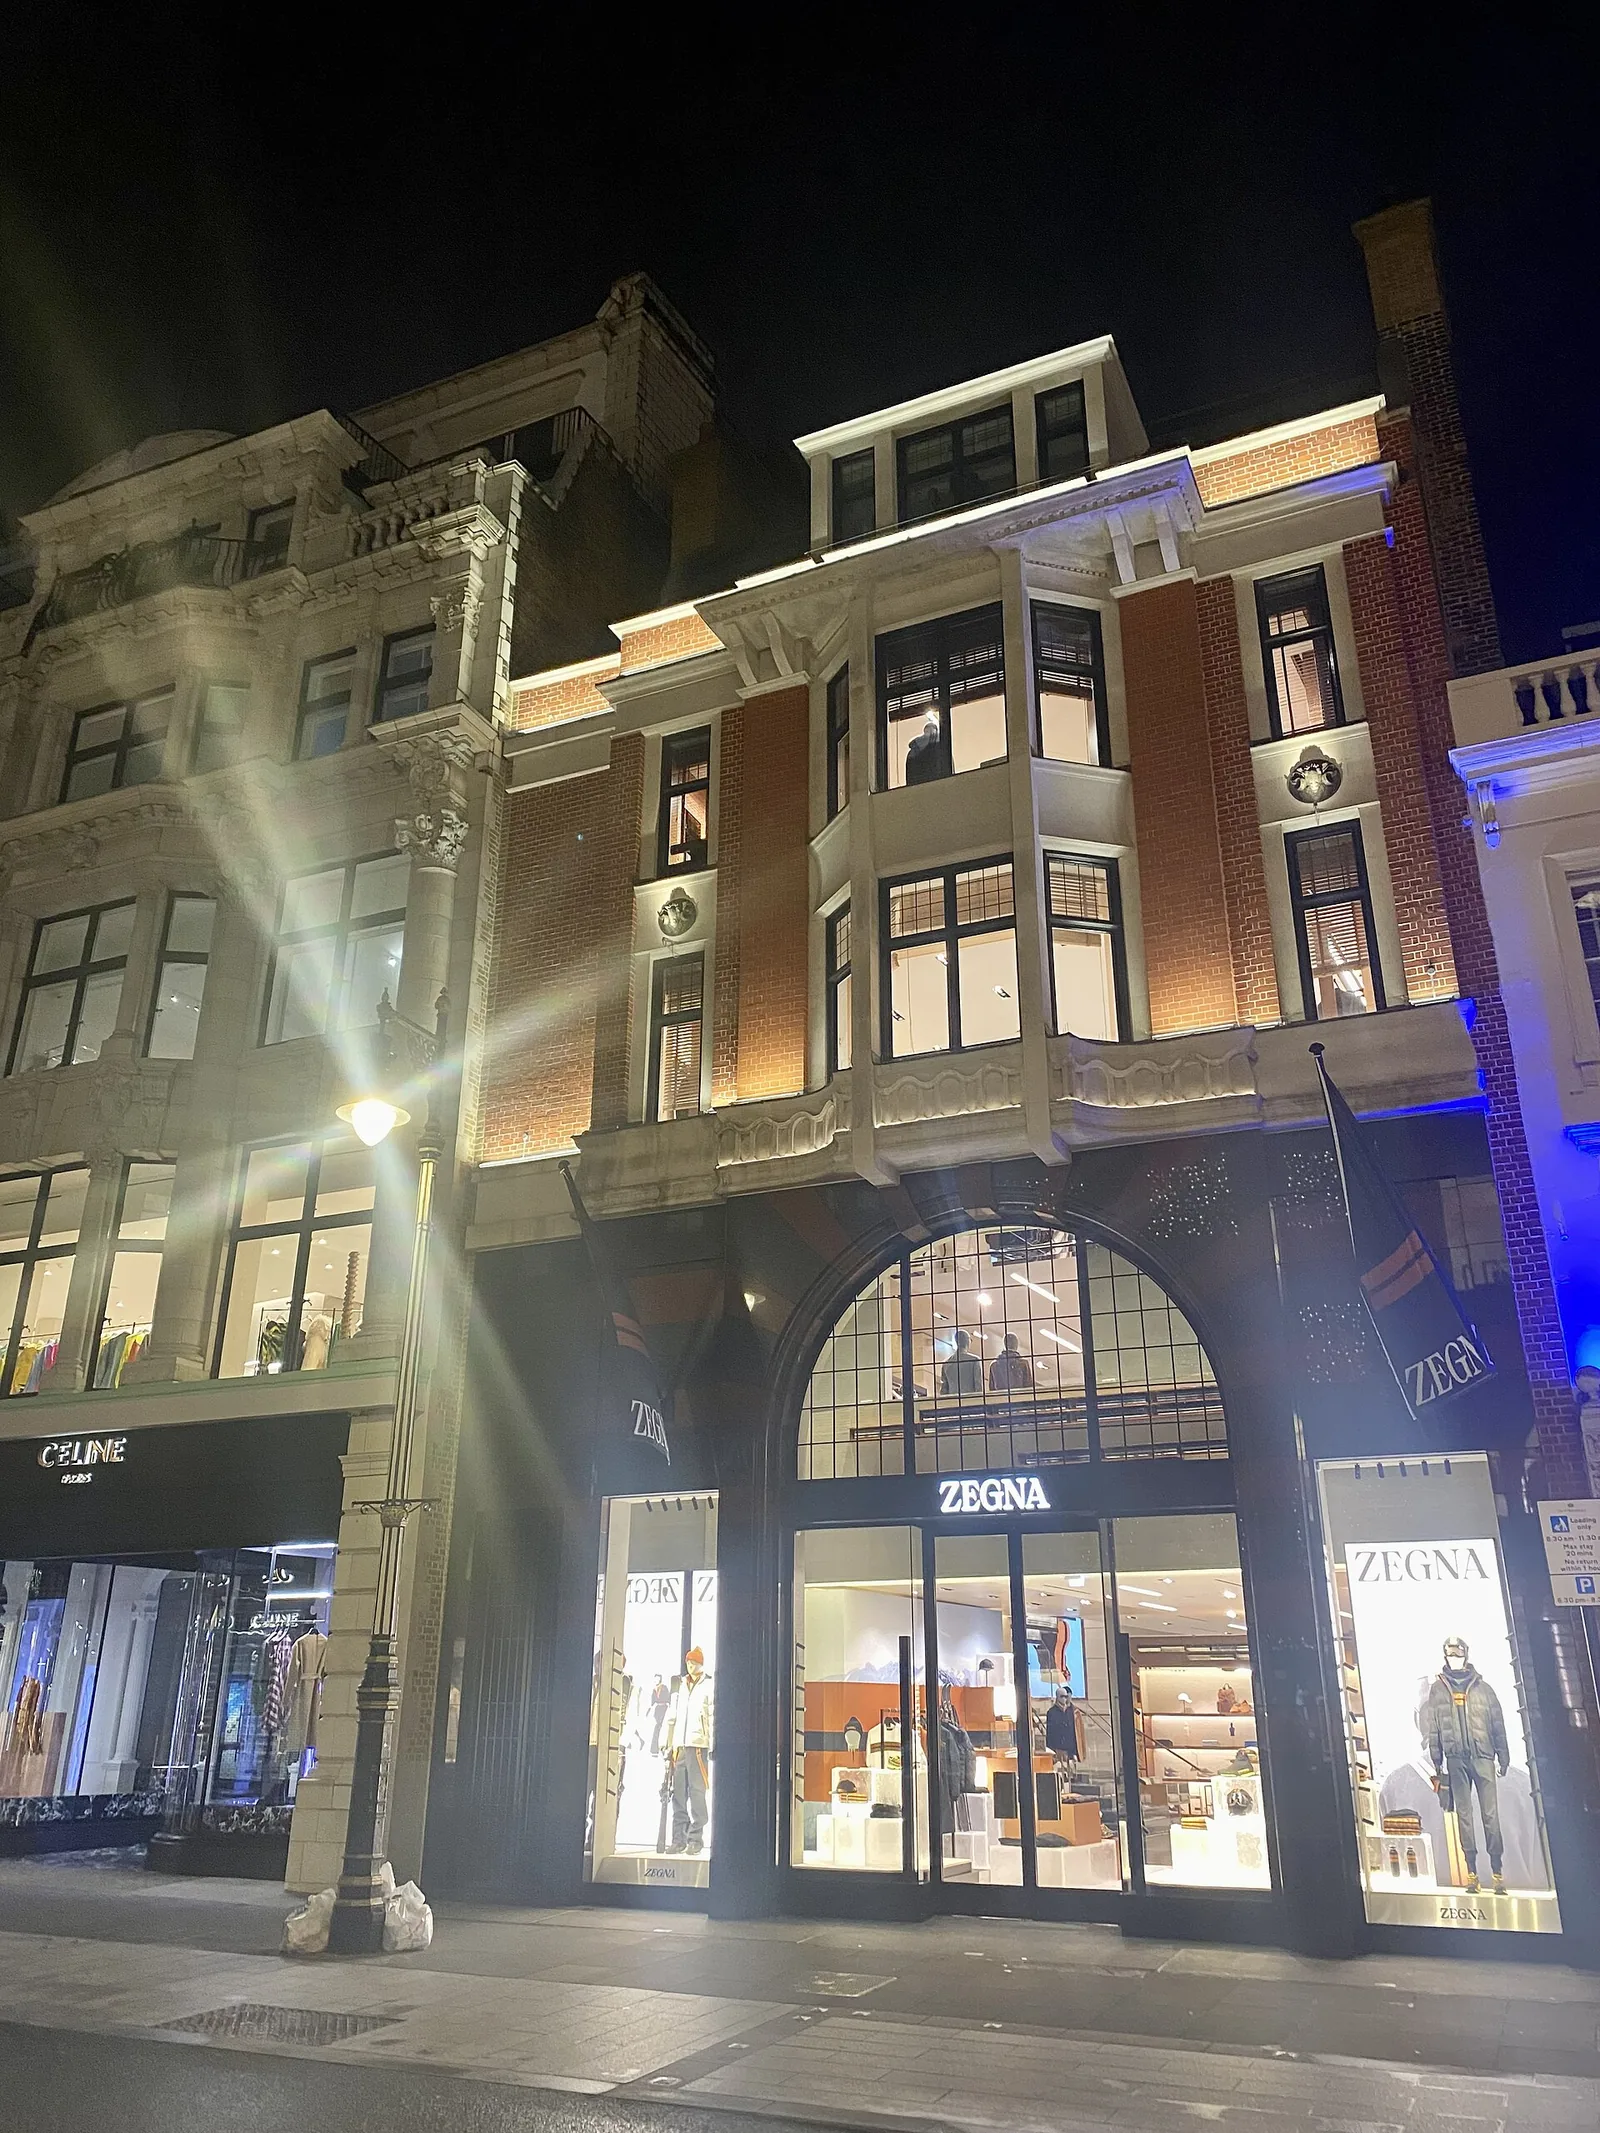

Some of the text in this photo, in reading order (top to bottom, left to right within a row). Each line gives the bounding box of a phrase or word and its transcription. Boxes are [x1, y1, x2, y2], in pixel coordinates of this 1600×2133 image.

[38, 1437, 127, 1468] CELINE
[939, 1477, 1051, 1514] ZEGNA
[1354, 1548, 1491, 1582] ZEGNA
[1579, 1578, 1592, 1593] P
[643, 1867, 676, 1879] ZEGNA
[1440, 1907, 1488, 1921] ZEGNA
